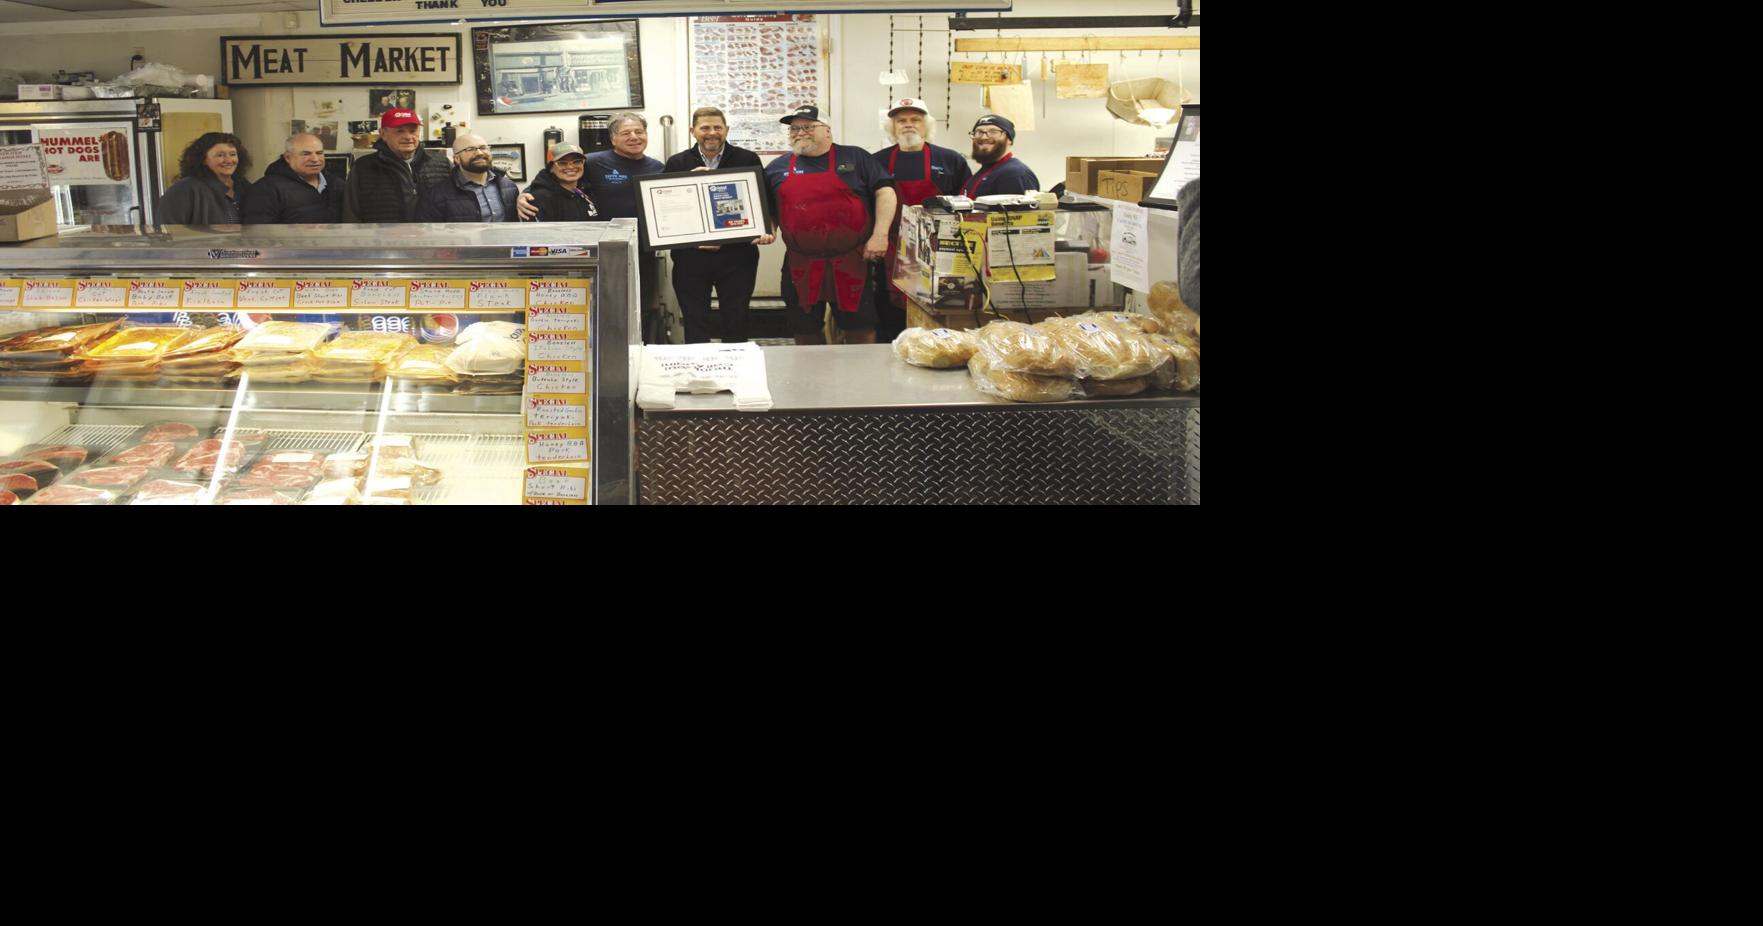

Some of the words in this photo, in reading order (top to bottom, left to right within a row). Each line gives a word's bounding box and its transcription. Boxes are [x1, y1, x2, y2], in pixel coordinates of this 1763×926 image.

[415, 0, 458, 9] THANK
[231, 44, 308, 80] MEAT
[339, 42, 450, 78] MARKET
[40, 137, 98, 146] HUMMEL
[68, 146, 100, 154] DOGS
